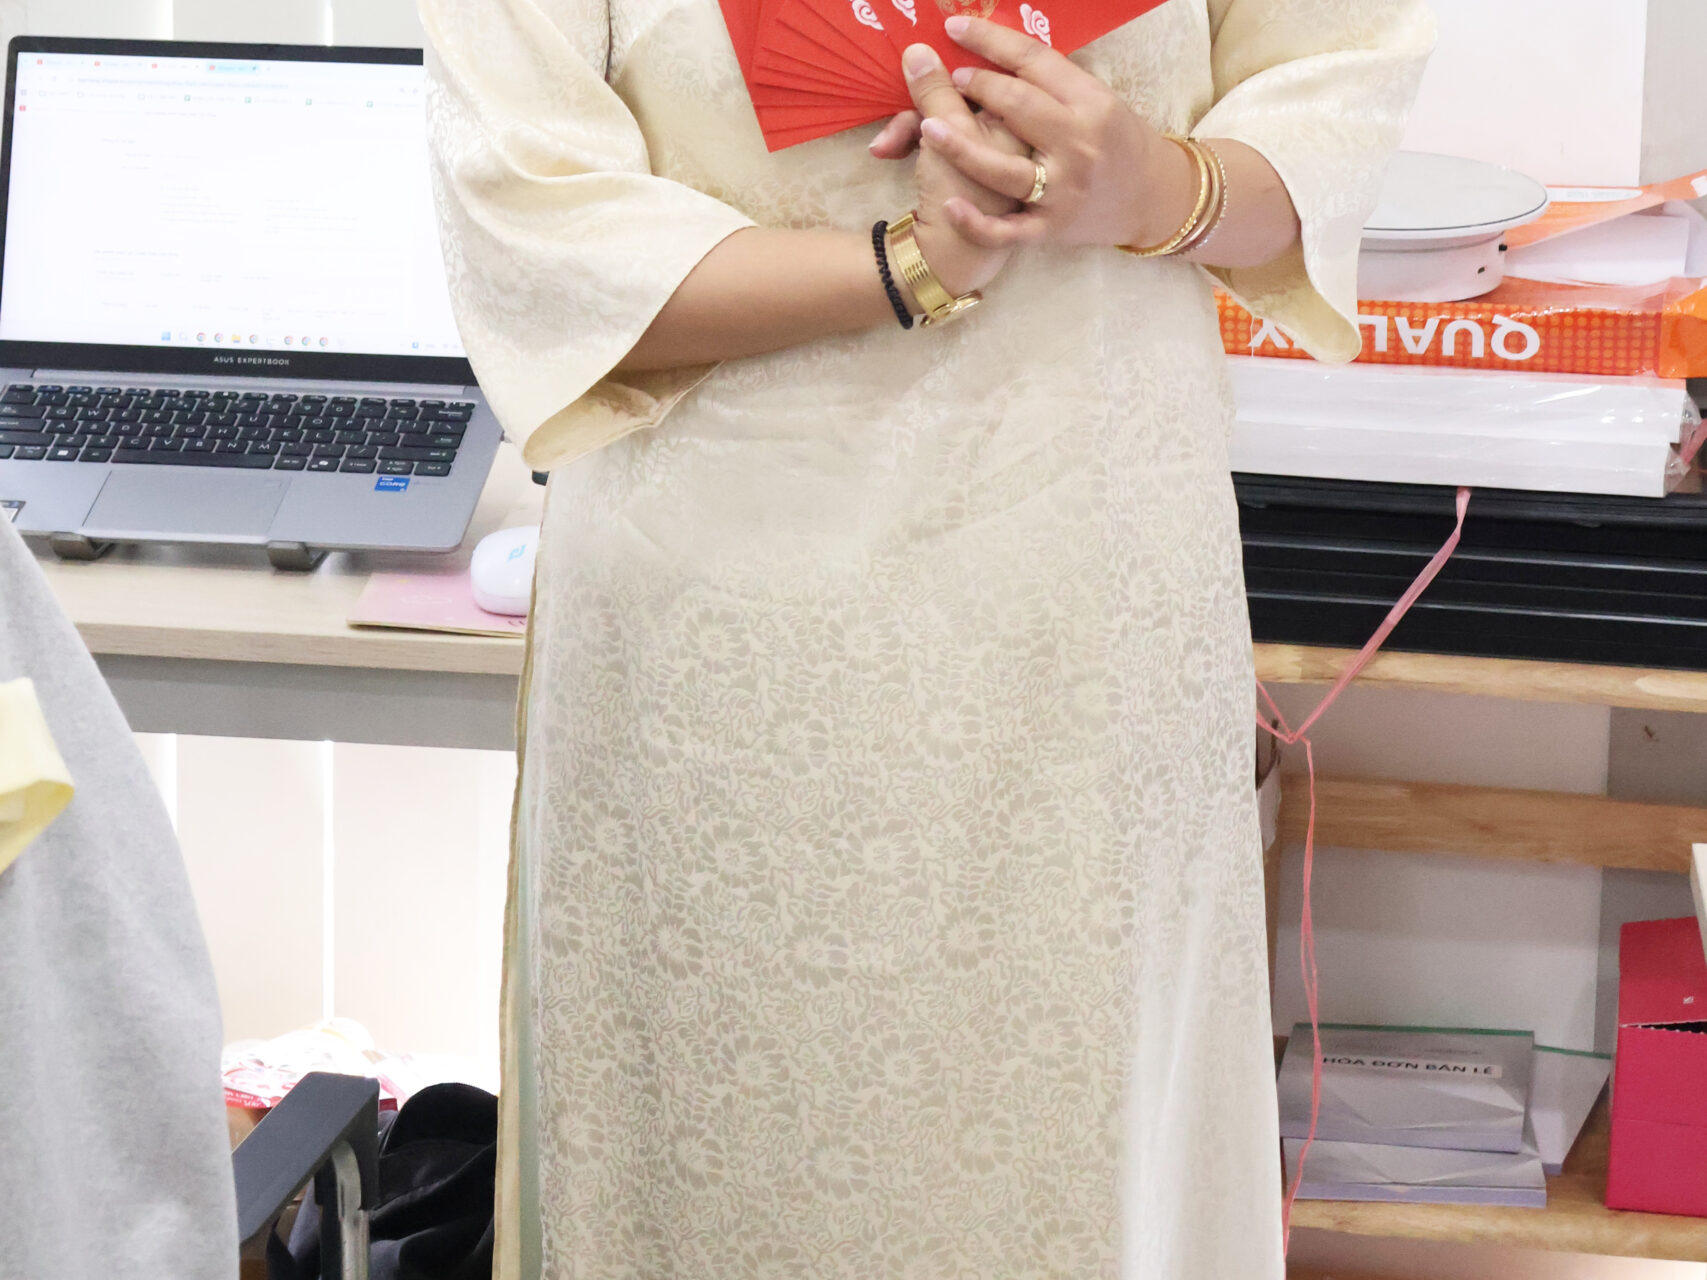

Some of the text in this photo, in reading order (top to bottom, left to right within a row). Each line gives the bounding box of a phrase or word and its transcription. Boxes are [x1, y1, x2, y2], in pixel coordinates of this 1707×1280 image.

[1247, 313, 1540, 361] QUALY
[214, 356, 234, 364] ASUS
[1372, 1060, 1419, 1070] ĐƠN
